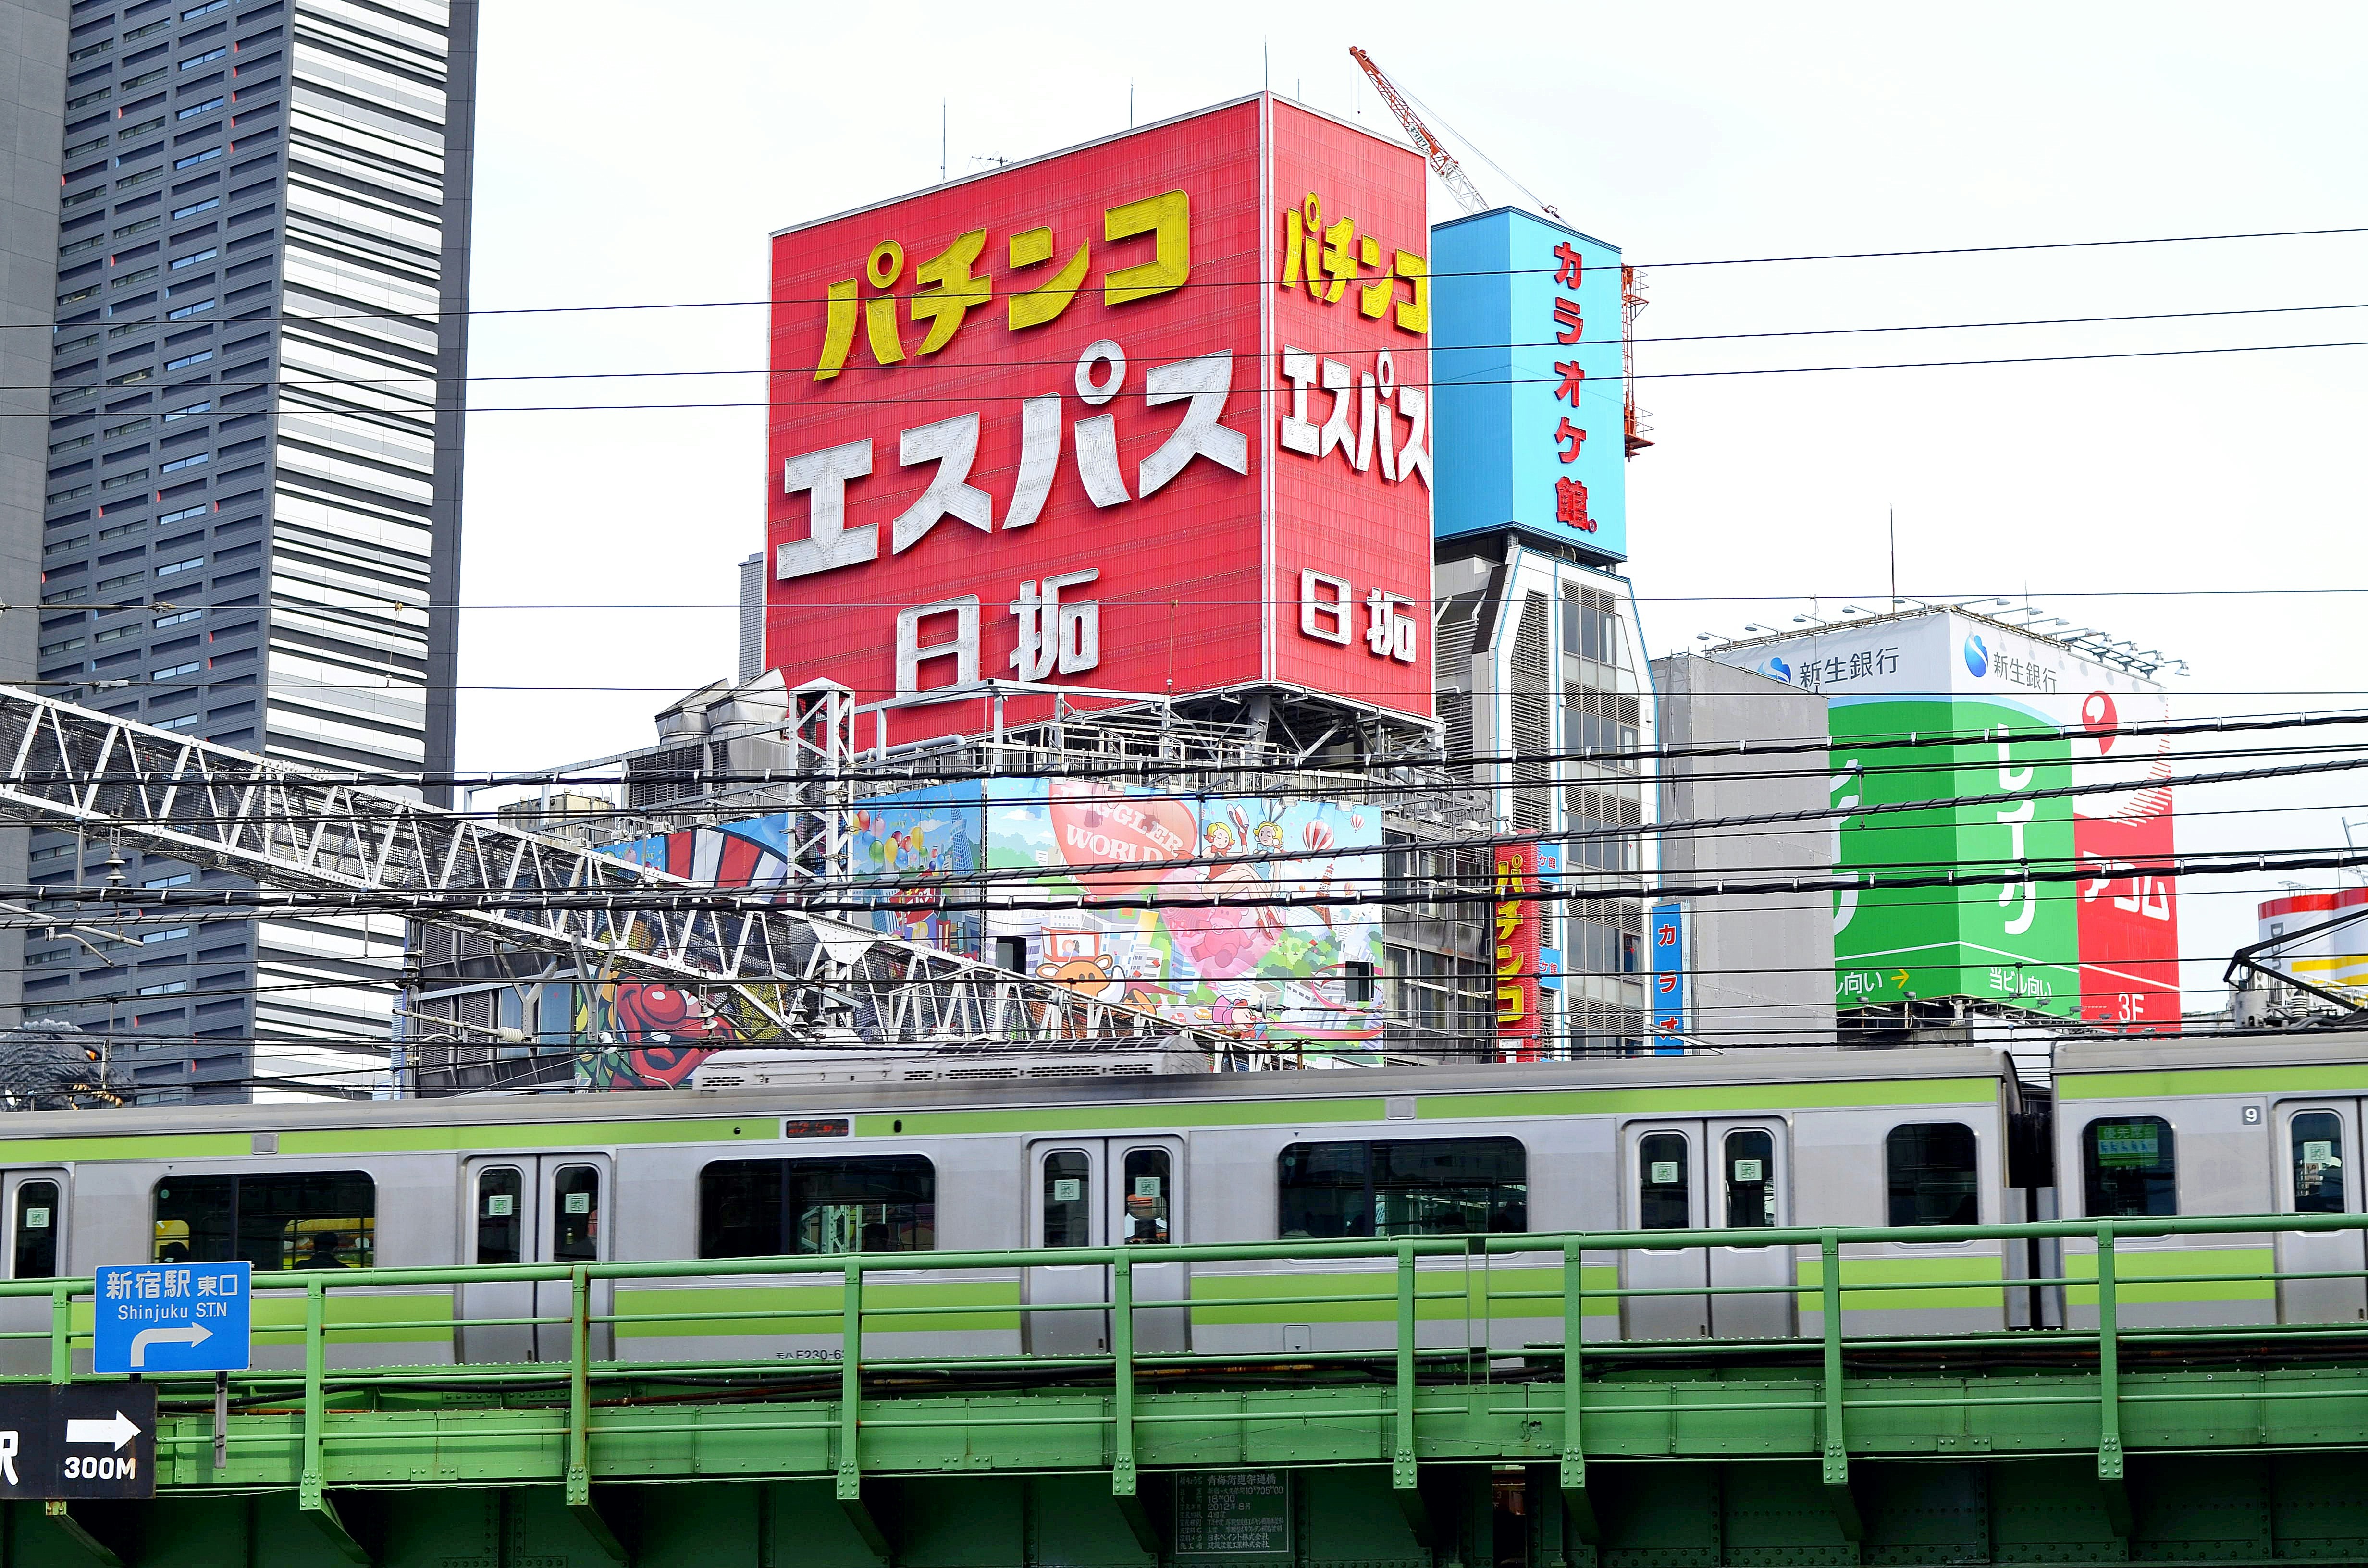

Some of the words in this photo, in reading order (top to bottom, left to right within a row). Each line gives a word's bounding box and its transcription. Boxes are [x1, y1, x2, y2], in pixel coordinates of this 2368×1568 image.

[814, 189, 1190, 381] パチンコ
[1282, 191, 1428, 334] パチンコ
[1281, 346, 1430, 492] エスパス
[1554, 241, 1588, 531] カラオケ館
[777, 339, 1248, 580] エスパス
[896, 568, 1099, 697] 日拓
[1300, 567, 1417, 663] 日拓
[1800, 647, 1899, 688] 新生銀行
[1993, 652, 2057, 694] 新生銀行
[1067, 824, 1164, 863] WORLD
[1997, 723, 2036, 935] レイク
[2083, 850, 2170, 921] アコム
[1495, 853, 1525, 1022] パチンコ
[1989, 966, 2053, 999] 当ビル向い
[2118, 991, 2144, 1022] 3F
[2245, 1108, 2258, 1122] 9
[106, 1269, 191, 1299] 新宿駅
[197, 1274, 238, 1297] 東口
[118, 1304, 188, 1323] Shinjuku
[65, 1457, 136, 1480] 300M
